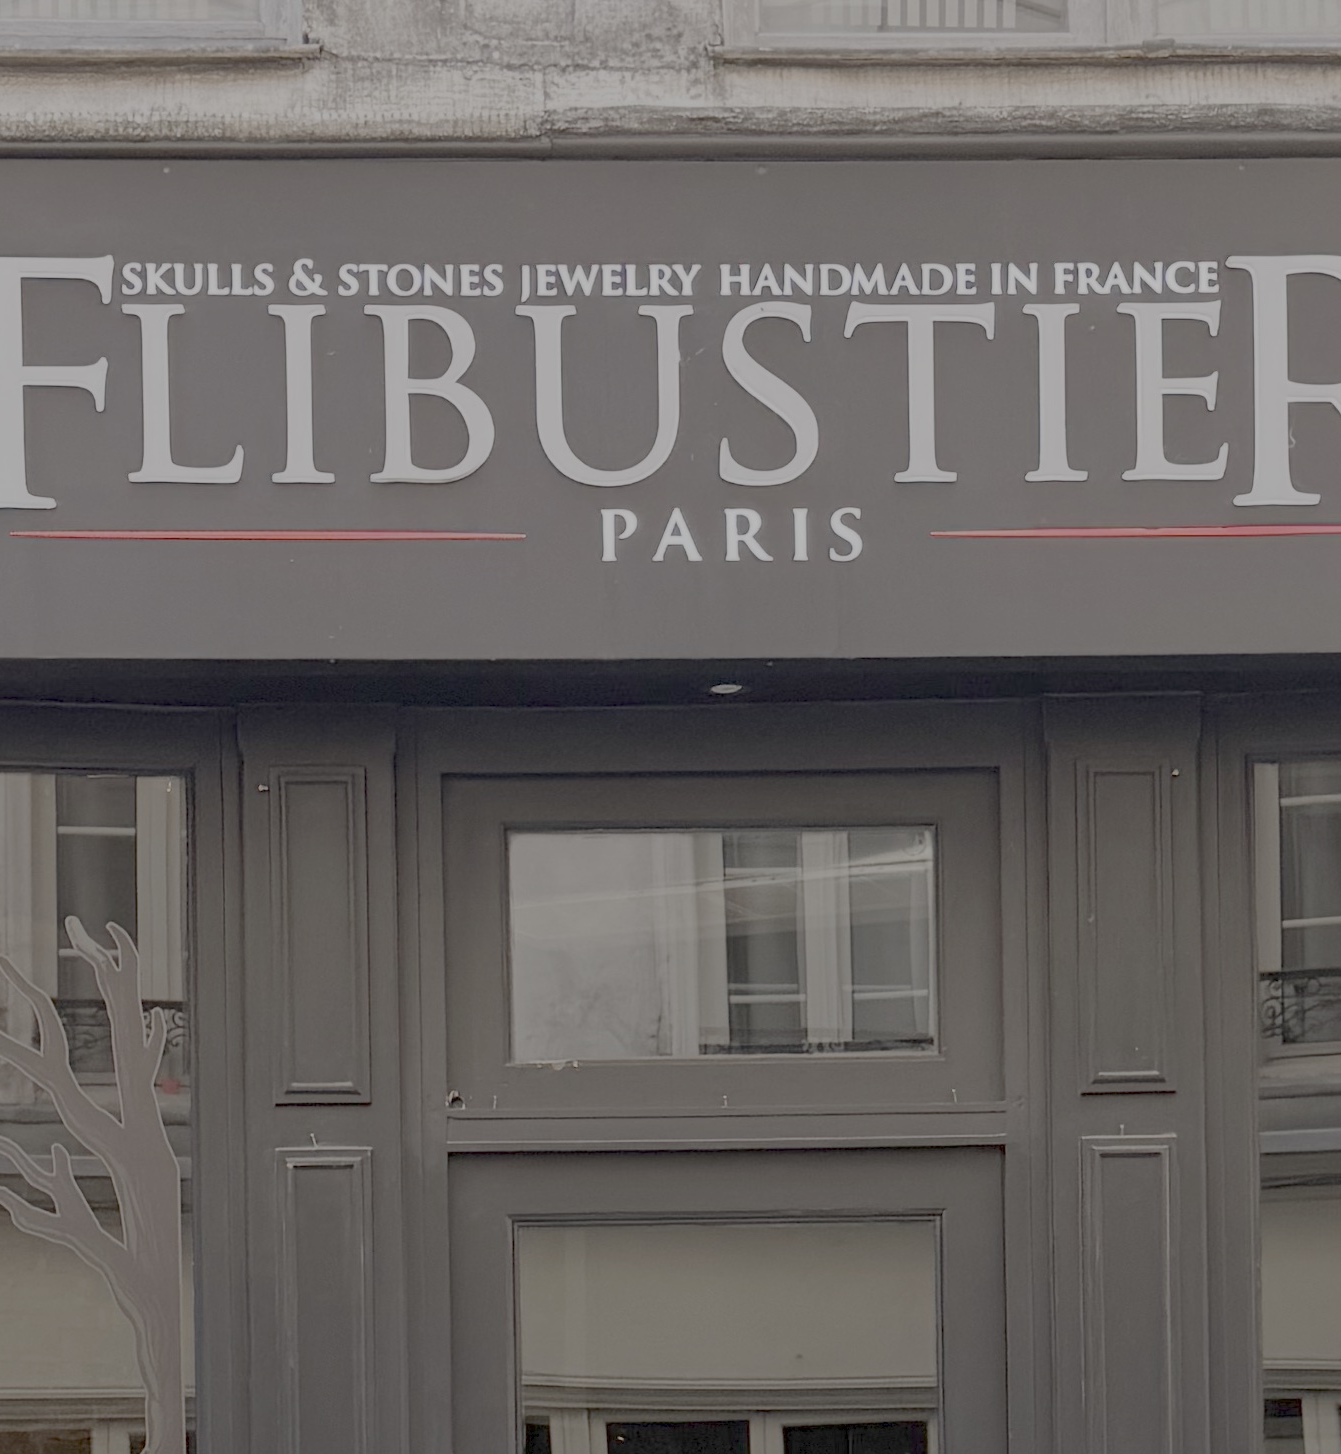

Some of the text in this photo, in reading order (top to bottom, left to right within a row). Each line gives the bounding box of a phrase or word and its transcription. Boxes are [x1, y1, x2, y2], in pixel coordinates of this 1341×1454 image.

[121, 258, 1220, 302] SKULLS & STONES JEWELRY HANDMADE IN FRANCE
[601, 505, 864, 562] PARIS
